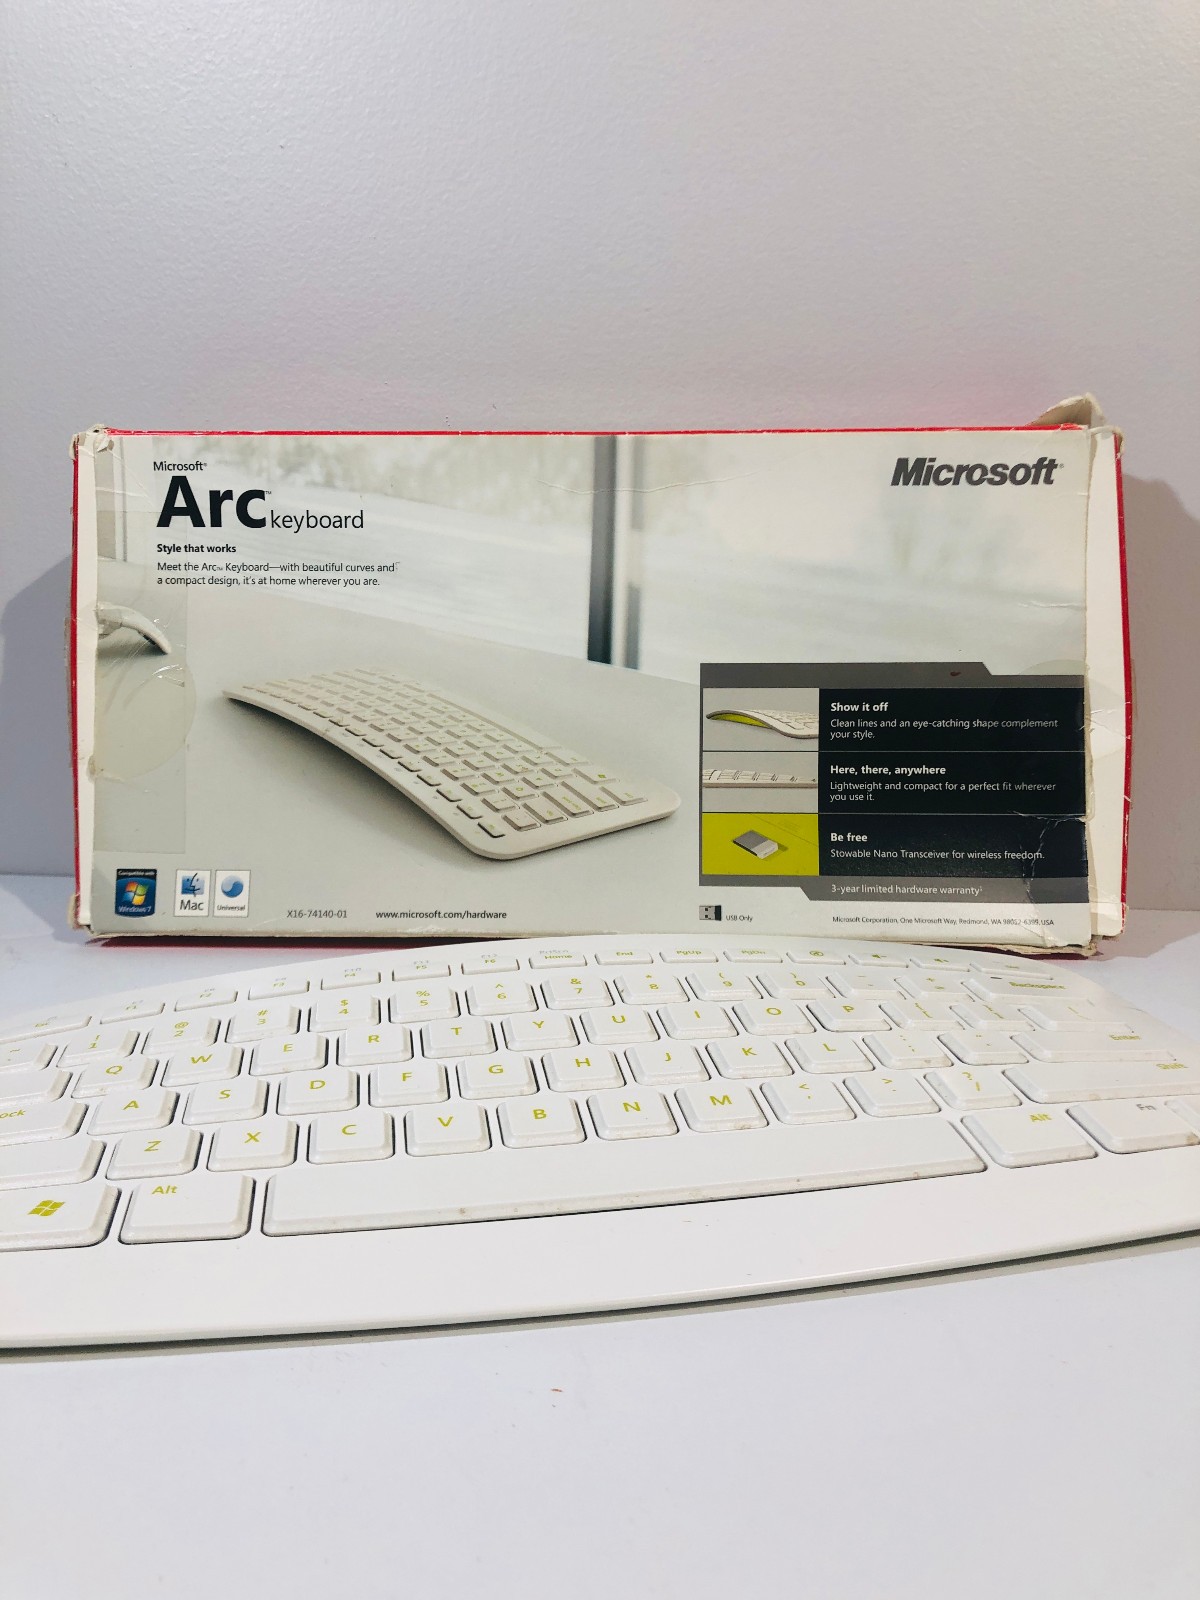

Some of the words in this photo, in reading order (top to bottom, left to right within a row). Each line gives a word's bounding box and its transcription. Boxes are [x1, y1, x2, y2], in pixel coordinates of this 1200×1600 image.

[270, 509, 364, 533] keyboard
[157, 544, 181, 555] Style
[184, 544, 204, 553] that
[207, 544, 236, 553] works
[158, 562, 181, 572] Meet
[184, 562, 199, 572] the
[303, 563, 342, 572] beautiful
[346, 565, 374, 573] curves
[377, 563, 394, 573] and
[165, 577, 206, 587] compact
[208, 576, 240, 588] design,
[244, 576, 255, 585] it's
[258, 577, 267, 585] at
[270, 576, 296, 586] home
[298, 576, 341, 586] wherever
[343, 579, 360, 588] you
[831, 702, 859, 711] Show
[862, 702, 870, 711] it
[873, 702, 888, 711] off
[831, 719, 855, 727] Clean
[858, 719, 877, 727] lines
[880, 719, 896, 727] and
[913, 719, 970, 729] eye-catching
[973, 719, 998, 729] shape
[1002, 719, 1058, 729] complement
[830, 732, 850, 740] your
[853, 730, 874, 740] style.
[831, 765, 857, 775] Here,
[861, 765, 891, 775] there,
[895, 765, 946, 776] anywhere
[830, 782, 882, 792] Lightweight
[885, 782, 901, 790] and
[904, 783, 942, 792] compact
[945, 782, 958, 790] for
[969, 782, 999, 792] perfect
[1003, 782, 1011, 790] fit
[1015, 782, 1055, 790] wherever
[830, 794, 846, 802] you
[866, 793, 875, 801] it.
[831, 833, 843, 841] Be
[847, 833, 867, 841] free
[831, 849, 870, 857] Stowable
[900, 850, 949, 858] Transceiver
[952, 850, 965, 858] for
[967, 851, 1001, 859] wireless
[1004, 851, 1045, 860] freedom.
[832, 884, 860, 894] 3-year
[862, 884, 893, 893] limited
[896, 885, 937, 894] hardware
[179, 899, 204, 911] Mac
[216, 904, 246, 912] Universal
[287, 910, 347, 918] X16-74140-01
[376, 910, 506, 919] www.microsoft.com/hardware
[943, 918, 957, 926] Way,
[765, 1007, 783, 1016] O
[843, 1005, 855, 1014] P
[532, 1020, 545, 1029] Y
[611, 1015, 626, 1024] U
[451, 1027, 462, 1036] T
[367, 1034, 381, 1044] R
[283, 1043, 293, 1053] E
[741, 1046, 757, 1057] K
[822, 1043, 837, 1053] L
[189, 1054, 213, 1065] W
[574, 1057, 591, 1068] H
[664, 1052, 672, 1062] J
[105, 1064, 123, 1076] Q
[487, 1063, 505, 1075] G
[401, 1071, 412, 1082] F
[309, 1079, 326, 1090] D
[219, 1089, 231, 1100] S
[123, 1100, 140, 1112] A
[709, 1094, 733, 1107] M
[622, 1101, 641, 1114] N
[1136, 1103, 1158, 1111] Fn
[0, 1109, 26, 1119] ock
[532, 1108, 547, 1120] B
[1029, 1112, 1053, 1123] Alt
[437, 1115, 454, 1128] V
[341, 1124, 357, 1137] C
[245, 1131, 262, 1144] X
[144, 1140, 161, 1153] Z
[152, 1184, 178, 1195] Alt
